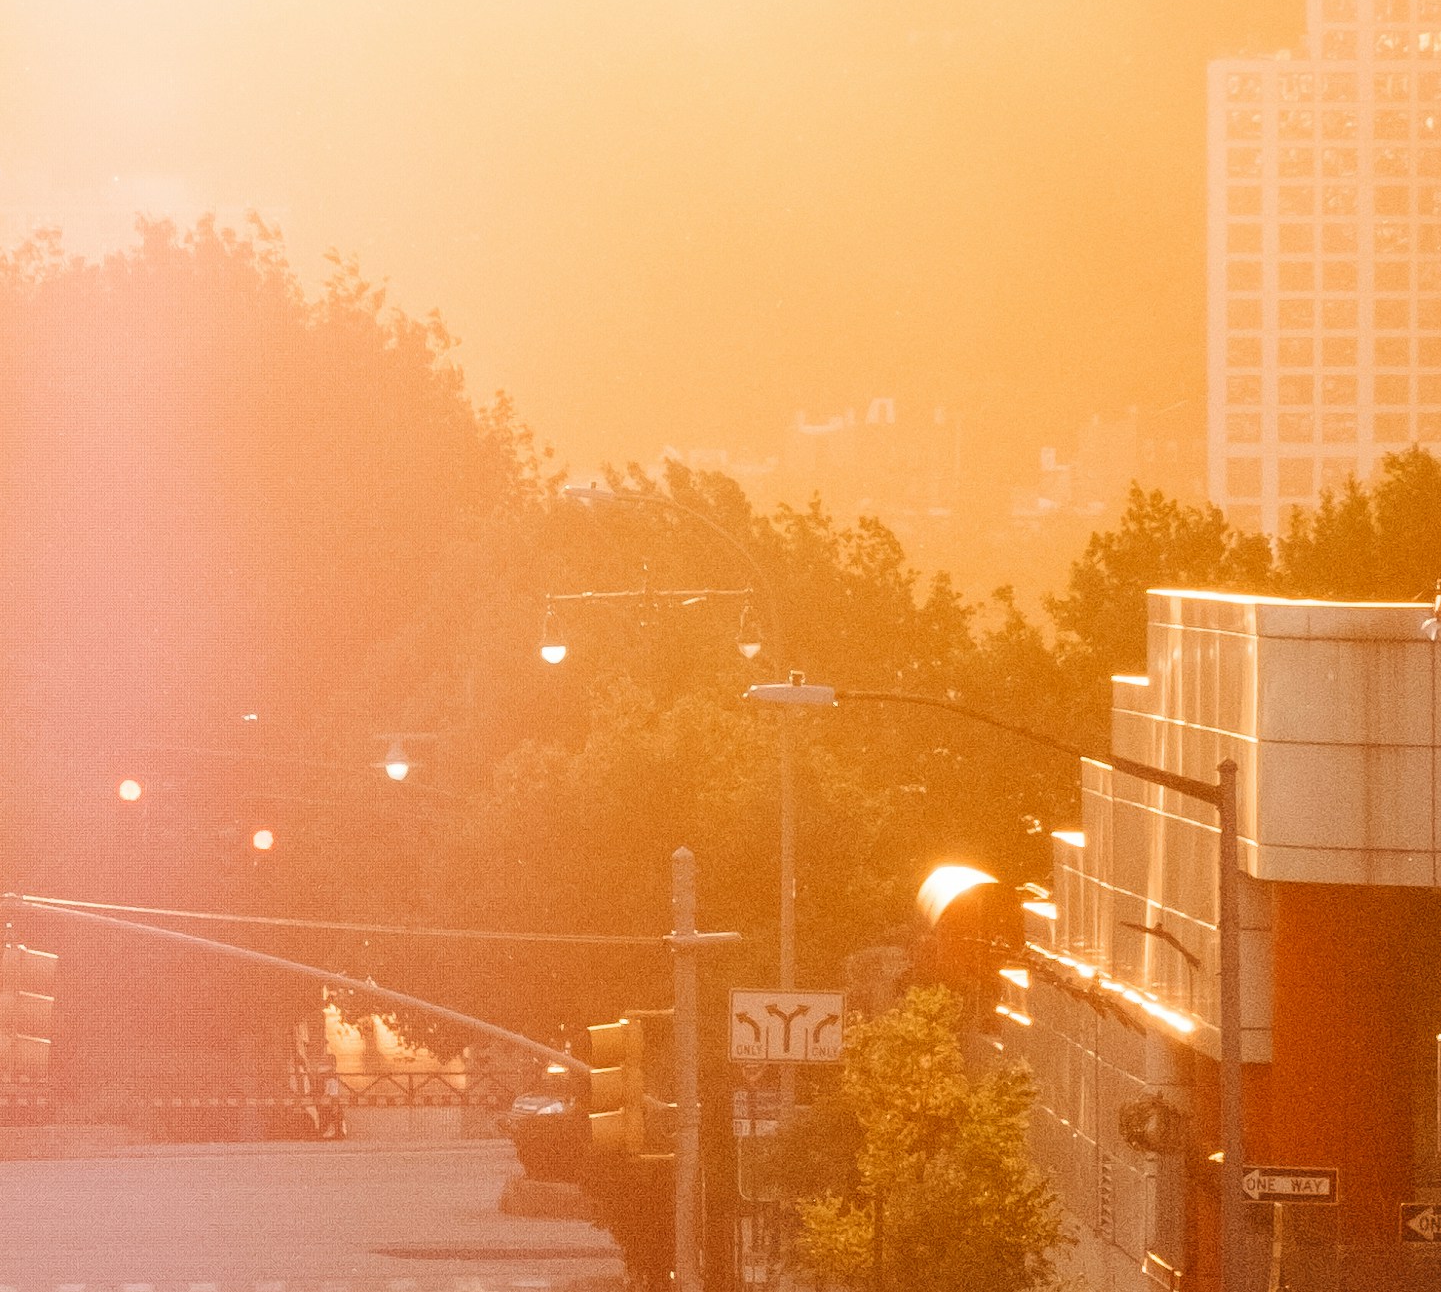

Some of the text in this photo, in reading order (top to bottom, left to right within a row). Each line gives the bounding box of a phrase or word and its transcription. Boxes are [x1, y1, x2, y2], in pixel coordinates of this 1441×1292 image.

[736, 1044, 762, 1056] ONLY
[1247, 1178, 1321, 1193] ONE WAY
